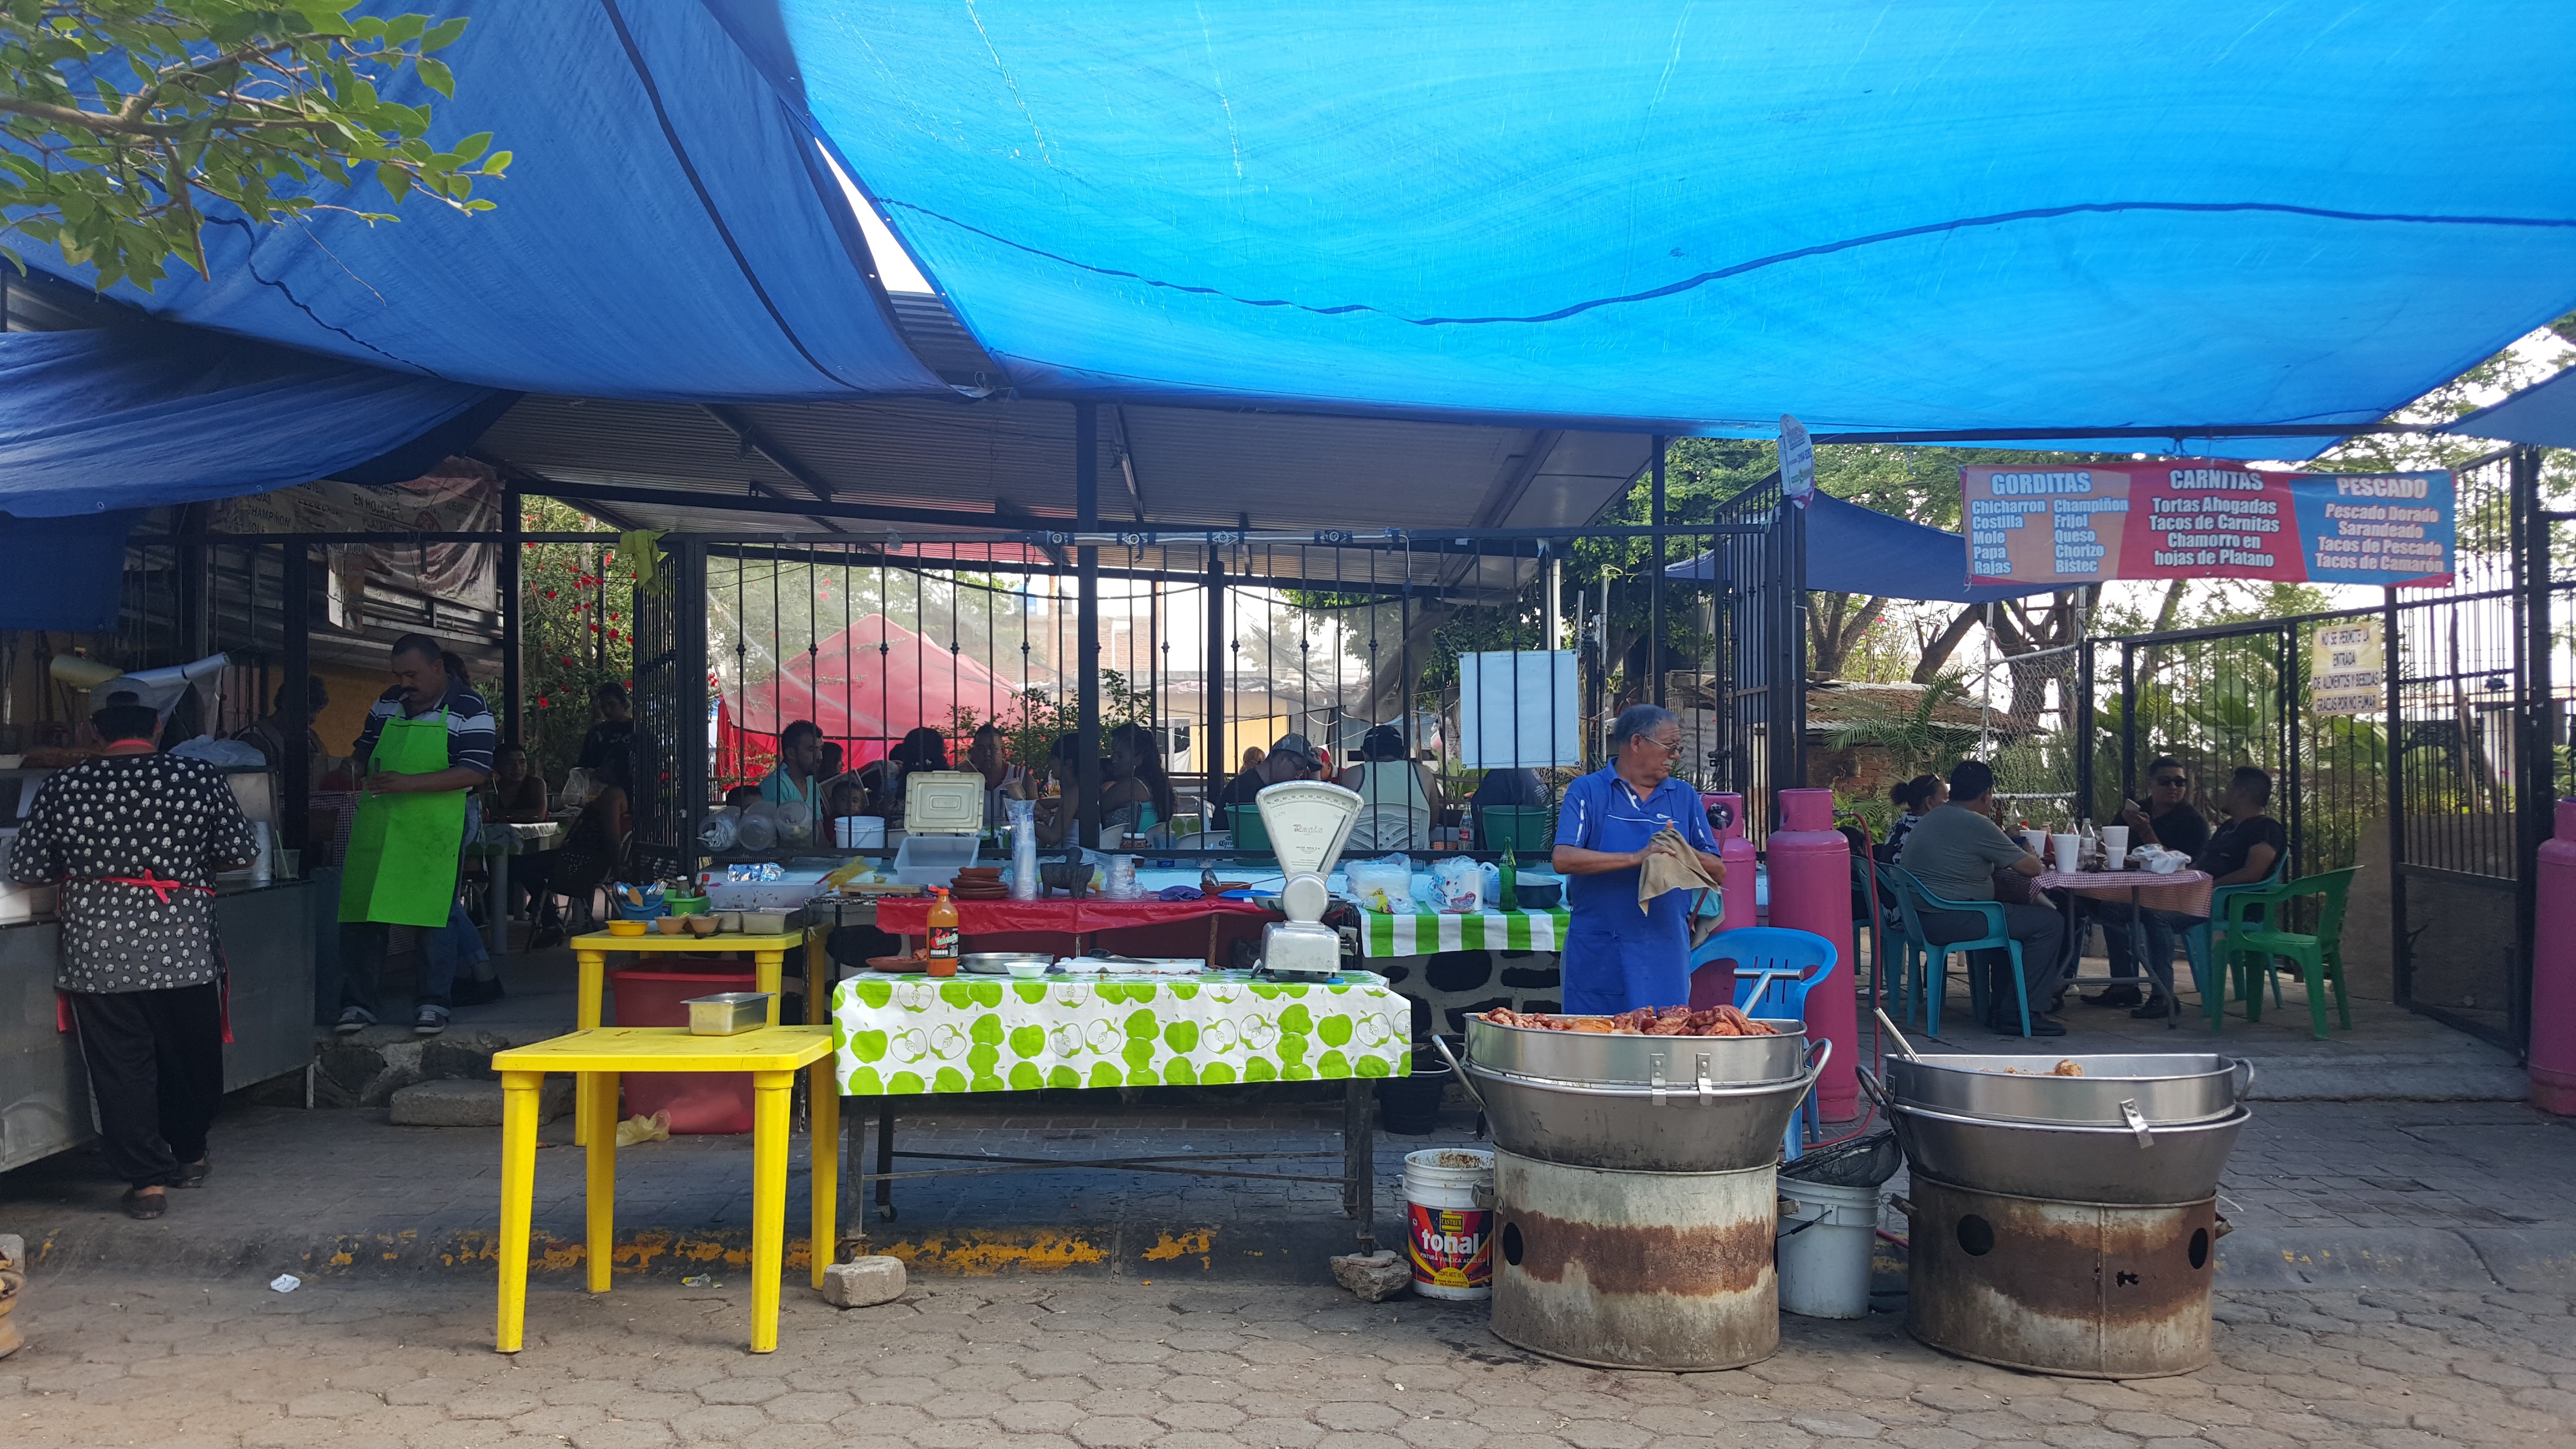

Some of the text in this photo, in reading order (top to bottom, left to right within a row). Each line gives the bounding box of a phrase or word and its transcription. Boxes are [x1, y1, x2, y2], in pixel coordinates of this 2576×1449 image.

[1992, 472, 2091, 495] GORDITAS
[2169, 469, 2264, 491] CARNITAS
[2337, 478, 2428, 499] PESCADO
[353, 493, 363, 508] EN
[1972, 500, 2046, 514] Chicharron
[2054, 497, 2129, 513] Champiñon
[2152, 496, 2278, 515] Tortas Ahogadas
[2325, 503, 2439, 523] Pescado Dorado
[1972, 515, 2024, 529] Costilla
[2054, 514, 2088, 529] Frijol
[2149, 514, 2280, 532] Tacos de Carnitas
[1973, 531, 2006, 545] Mole
[2054, 529, 2096, 544] Queso
[2338, 521, 2424, 539] Sarandeado
[2168, 532, 2261, 549] Chamorro en
[2317, 536, 2443, 556] Tacos de Pescado
[1973, 546, 2007, 560] Papa
[2055, 544, 2104, 558] Chorizo
[2154, 549, 2274, 567] hojas de Platano
[1974, 561, 2011, 575] Rajas
[2055, 560, 2098, 573] Bistec
[2316, 553, 2444, 573] Tacos de Camarón
[1441, 1218, 1462, 1226] CASTHER
[1422, 1228, 1479, 1254] tonal
